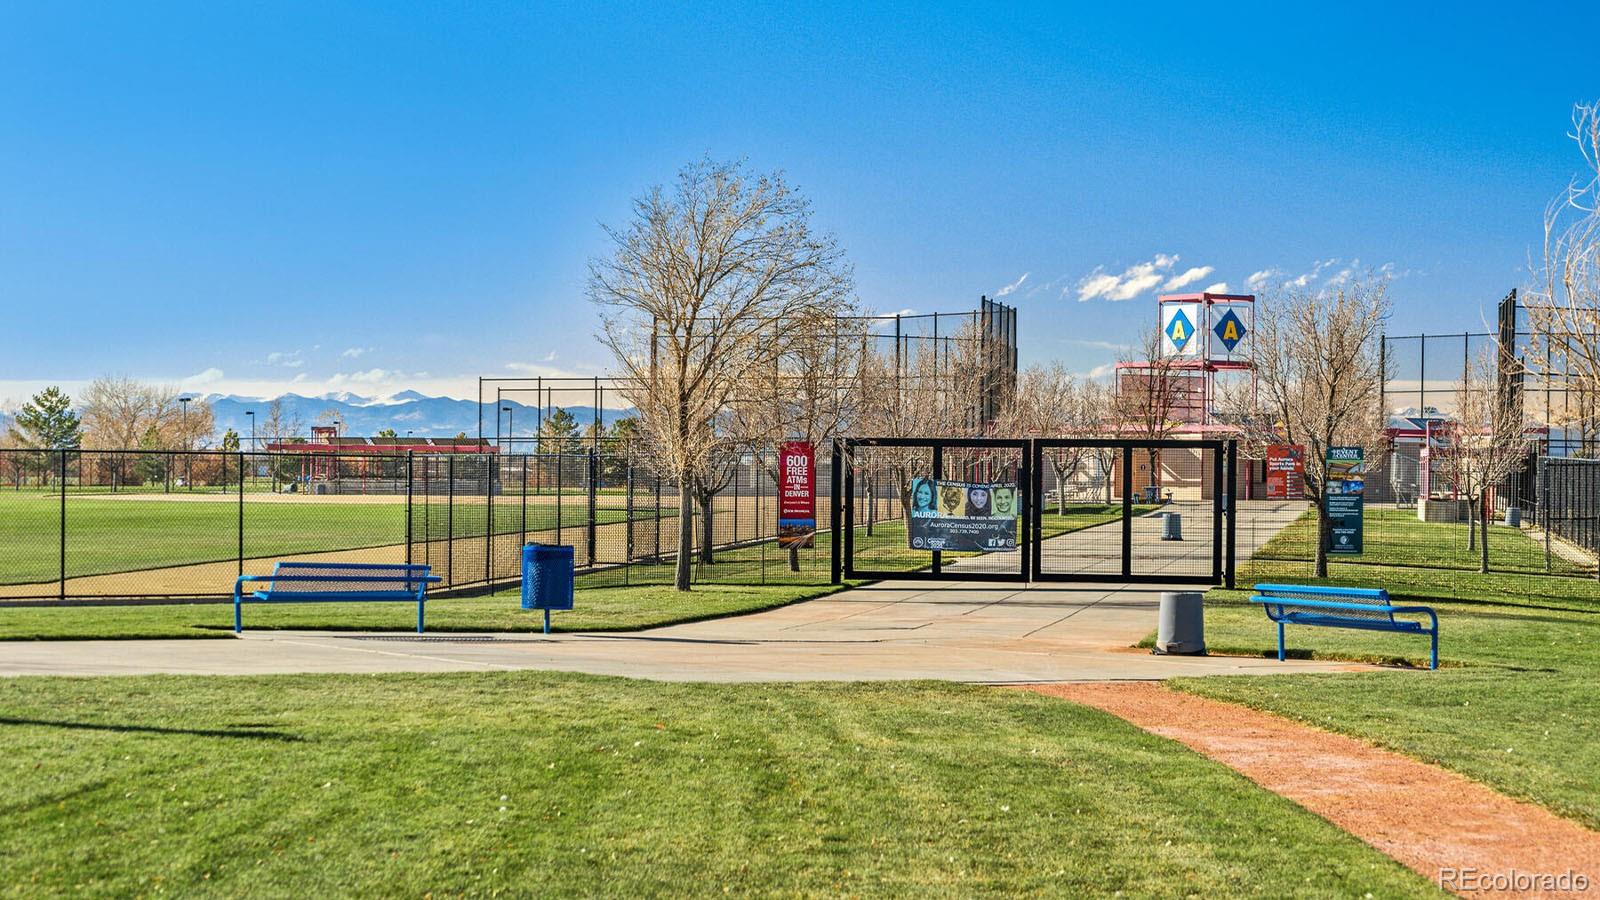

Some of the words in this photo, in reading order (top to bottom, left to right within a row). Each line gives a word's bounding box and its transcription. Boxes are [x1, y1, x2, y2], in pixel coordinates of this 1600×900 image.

[1172, 320, 1186, 340] A
[1223, 320, 1239, 340] A
[786, 455, 808, 466] 600
[786, 467, 808, 475] FREE
[786, 476, 808, 484] ATMs
[930, 522, 999, 530] AuroraCensus2020.org
